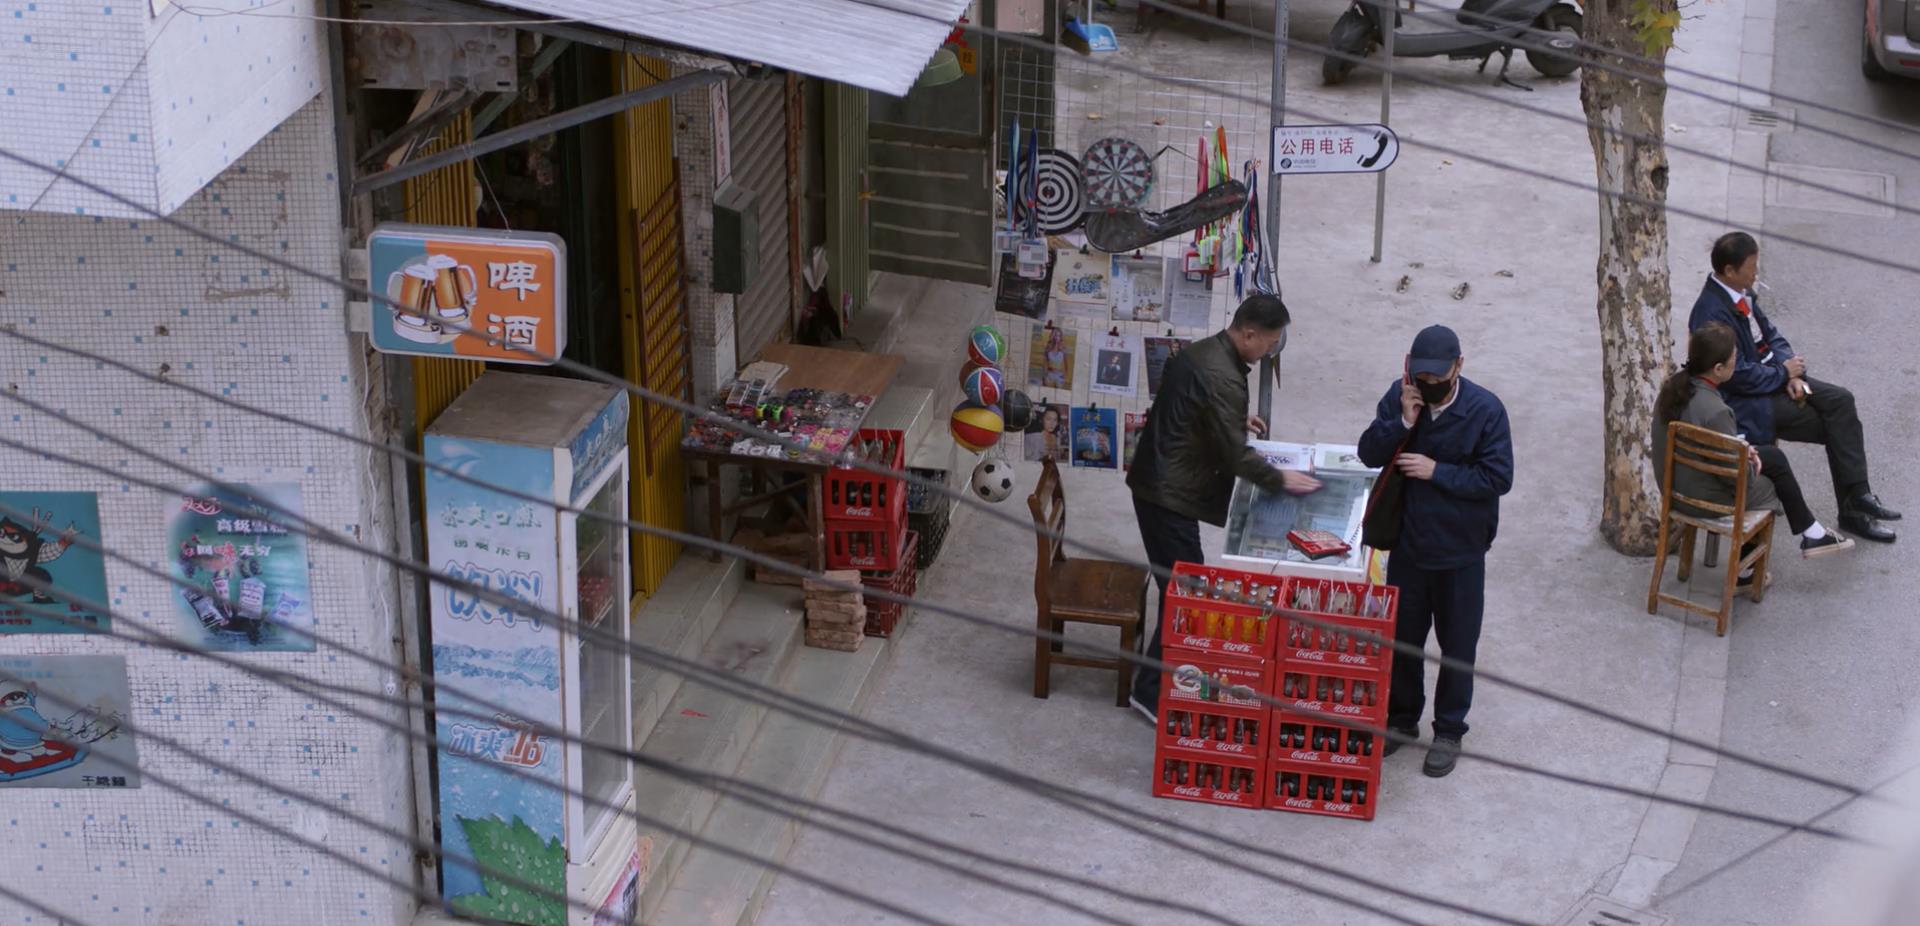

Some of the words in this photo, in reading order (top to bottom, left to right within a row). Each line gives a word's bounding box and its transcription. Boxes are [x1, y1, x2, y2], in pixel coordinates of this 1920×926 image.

[1281, 137, 1354, 155] 公用电话
[487, 260, 541, 351] 啤酒
